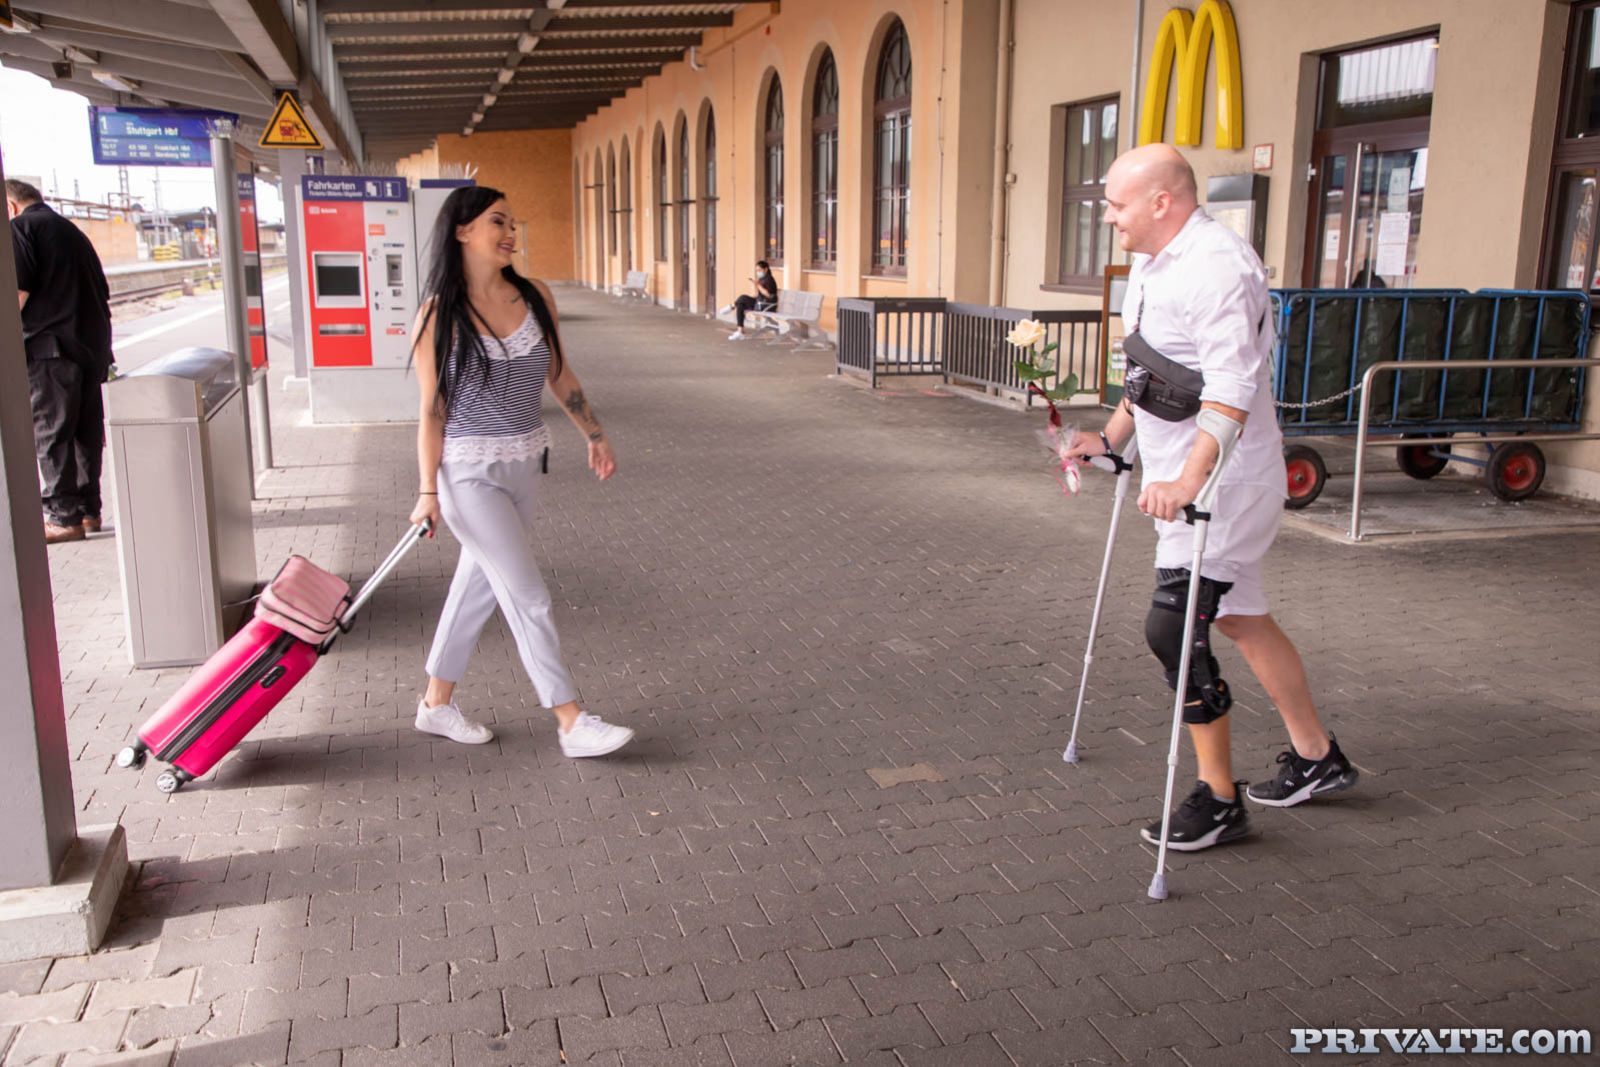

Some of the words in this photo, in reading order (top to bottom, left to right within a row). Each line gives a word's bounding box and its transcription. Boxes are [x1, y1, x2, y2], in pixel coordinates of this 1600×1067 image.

[100, 116, 107, 130] 1
[126, 127, 162, 136] Stuttgart
[308, 181, 356, 190] Fahrkarten
